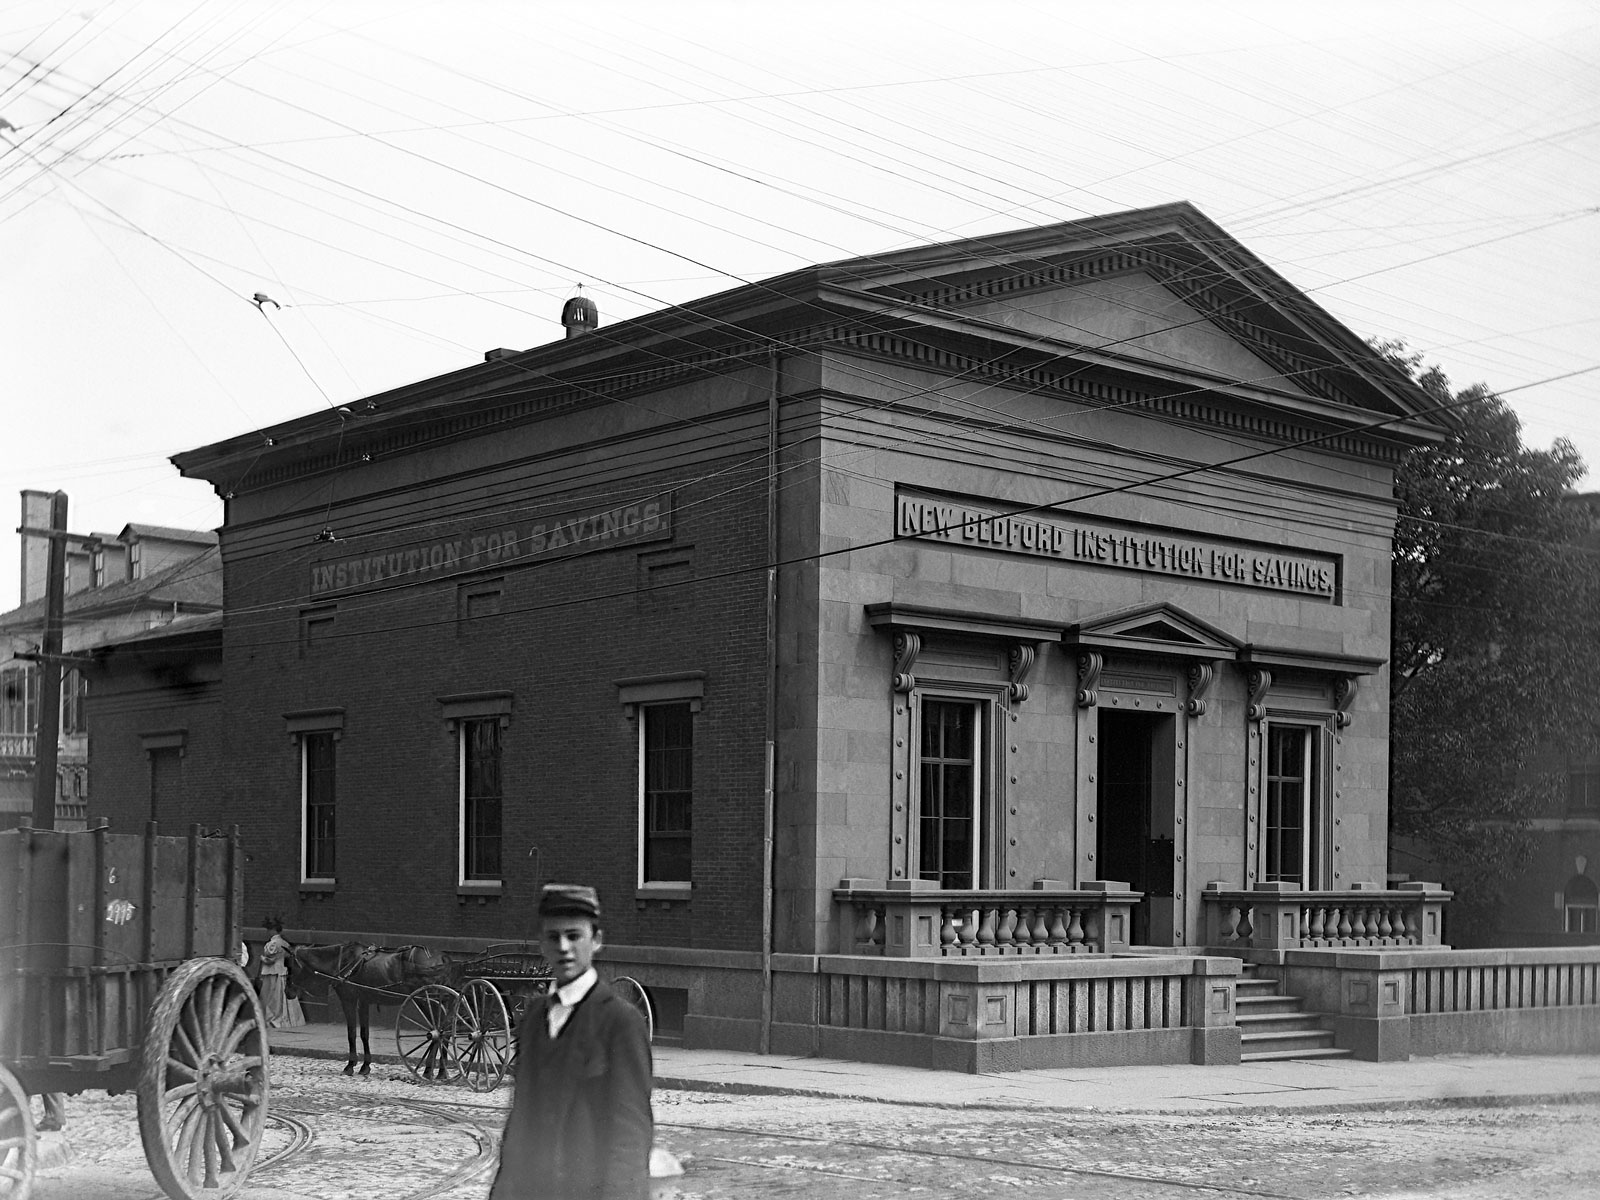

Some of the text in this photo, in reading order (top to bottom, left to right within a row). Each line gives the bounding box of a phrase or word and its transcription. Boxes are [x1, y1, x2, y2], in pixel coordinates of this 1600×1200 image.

[312, 502, 666, 593] INSTITUTION FOR SAVINGS.
[902, 500, 1334, 592] NEW BEDFORD INSTITUTION FOR SAVINGS.
